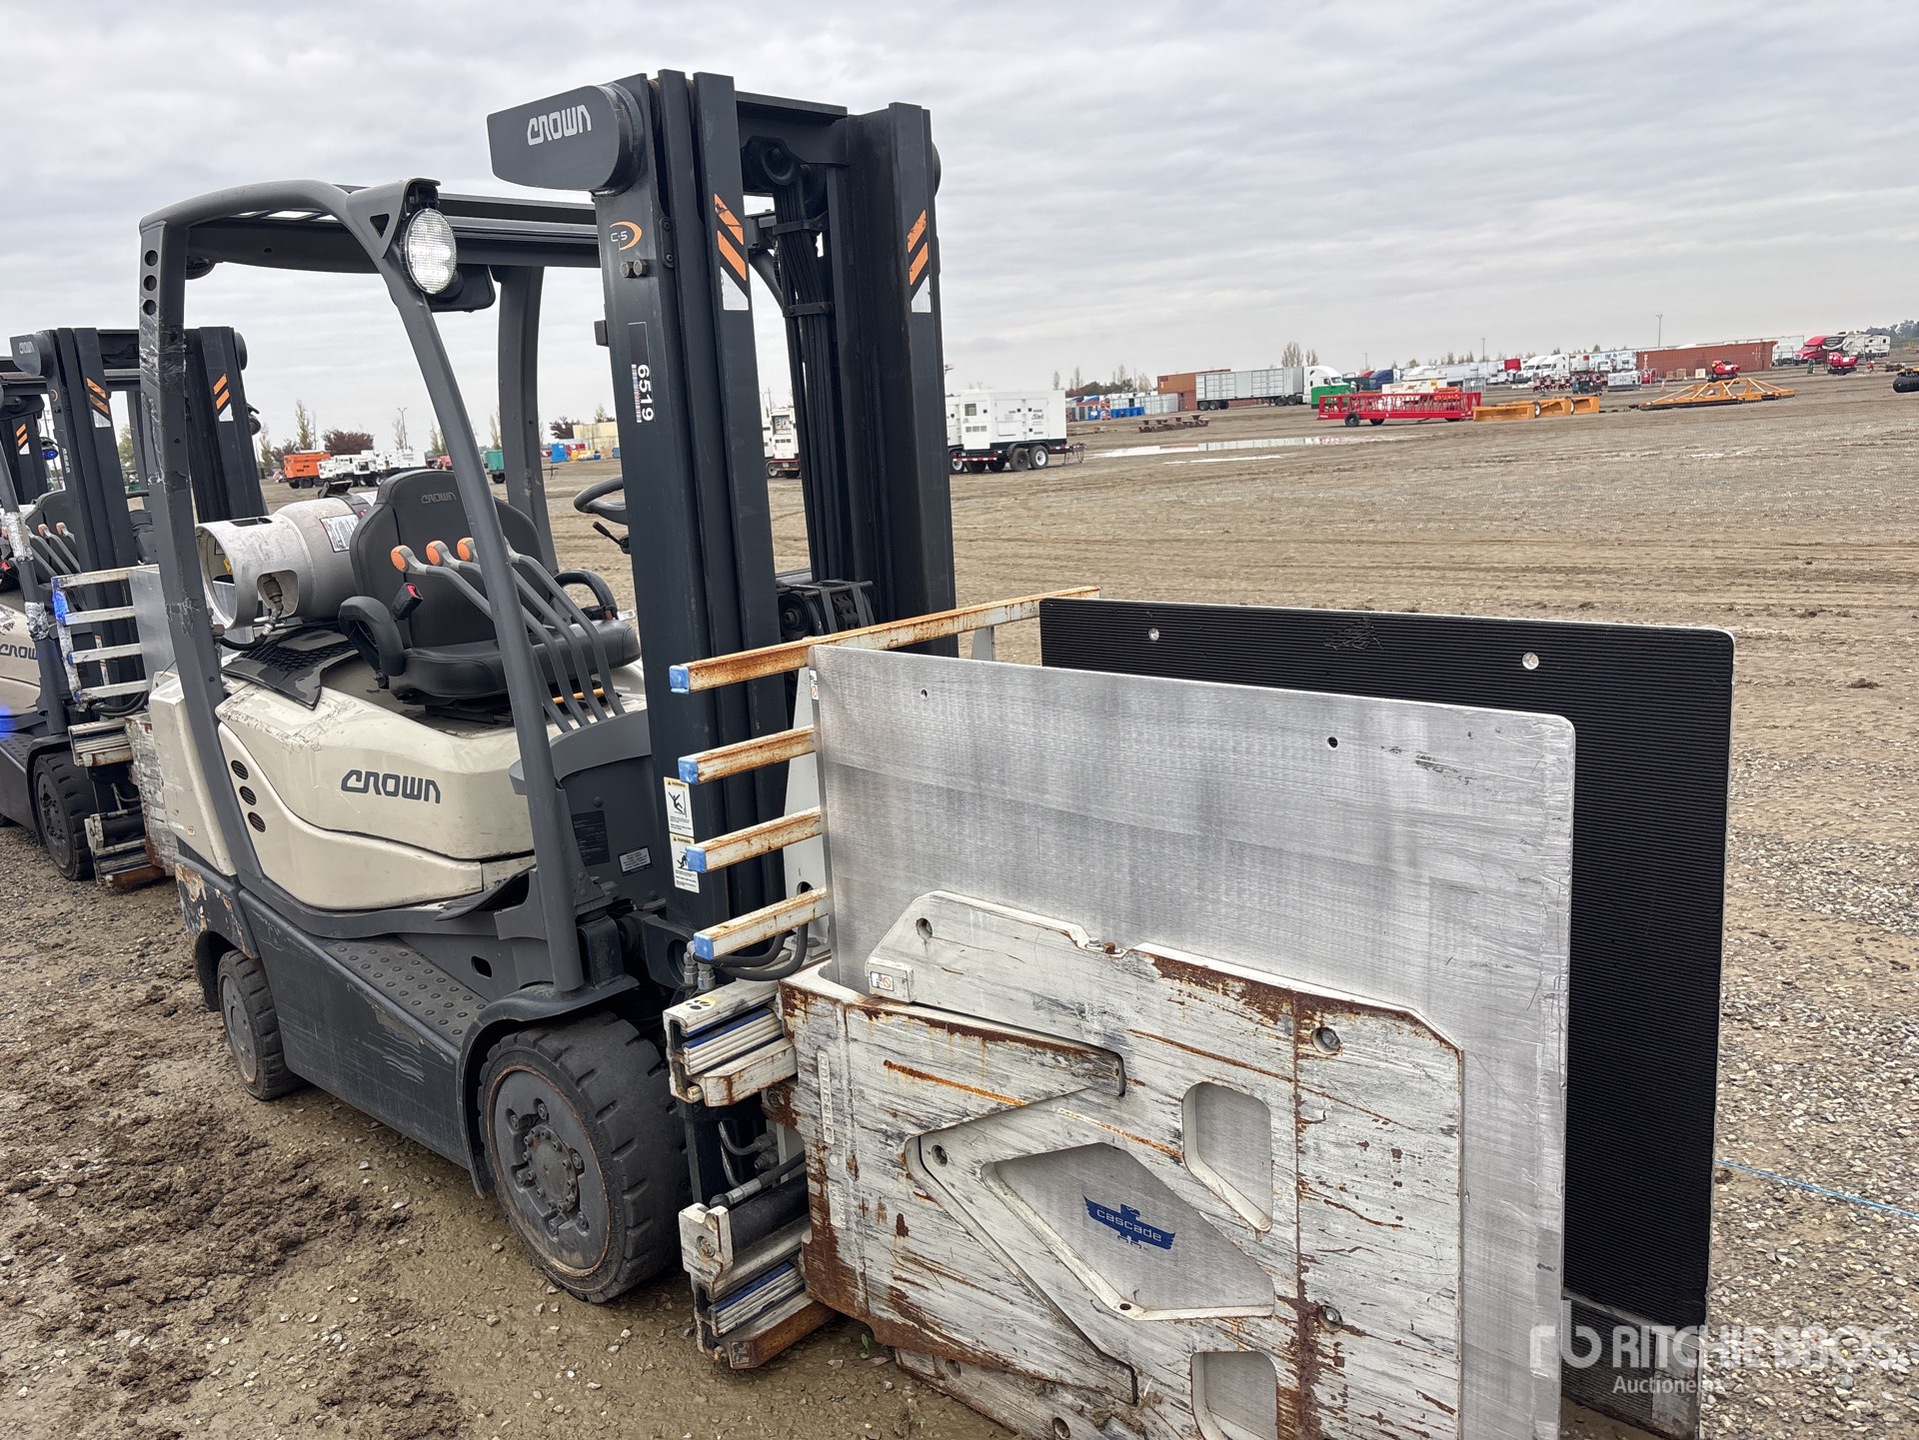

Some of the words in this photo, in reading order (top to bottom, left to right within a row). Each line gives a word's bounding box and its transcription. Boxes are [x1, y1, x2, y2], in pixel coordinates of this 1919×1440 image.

[527, 104, 592, 146] CROWN
[610, 230, 628, 243] C-5
[637, 364, 655, 421] 6519
[420, 491, 457, 504] CROWN
[0, 643, 38, 660] CROW
[340, 769, 441, 804] CROWN
[1096, 1208, 1162, 1242] cascade
